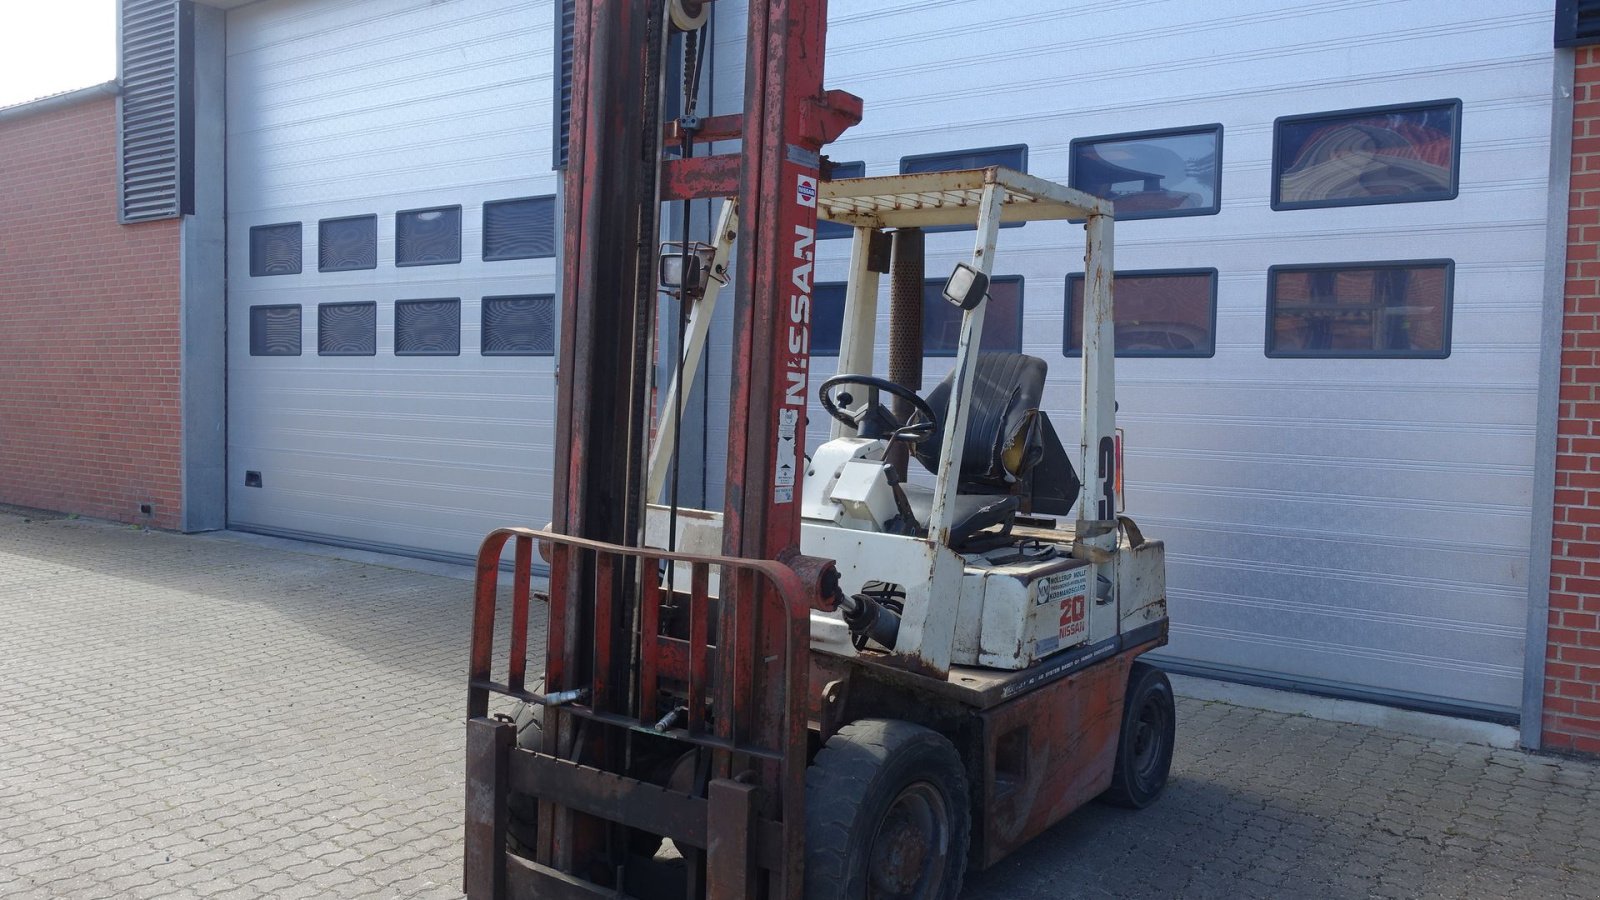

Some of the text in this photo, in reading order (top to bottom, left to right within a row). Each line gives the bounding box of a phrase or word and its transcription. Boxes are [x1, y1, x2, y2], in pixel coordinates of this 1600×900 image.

[786, 225, 814, 405] NISSAN
[1098, 436, 1114, 521] 3
[1059, 622, 1084, 639] NISSAN
[1060, 595, 1084, 626] 20
